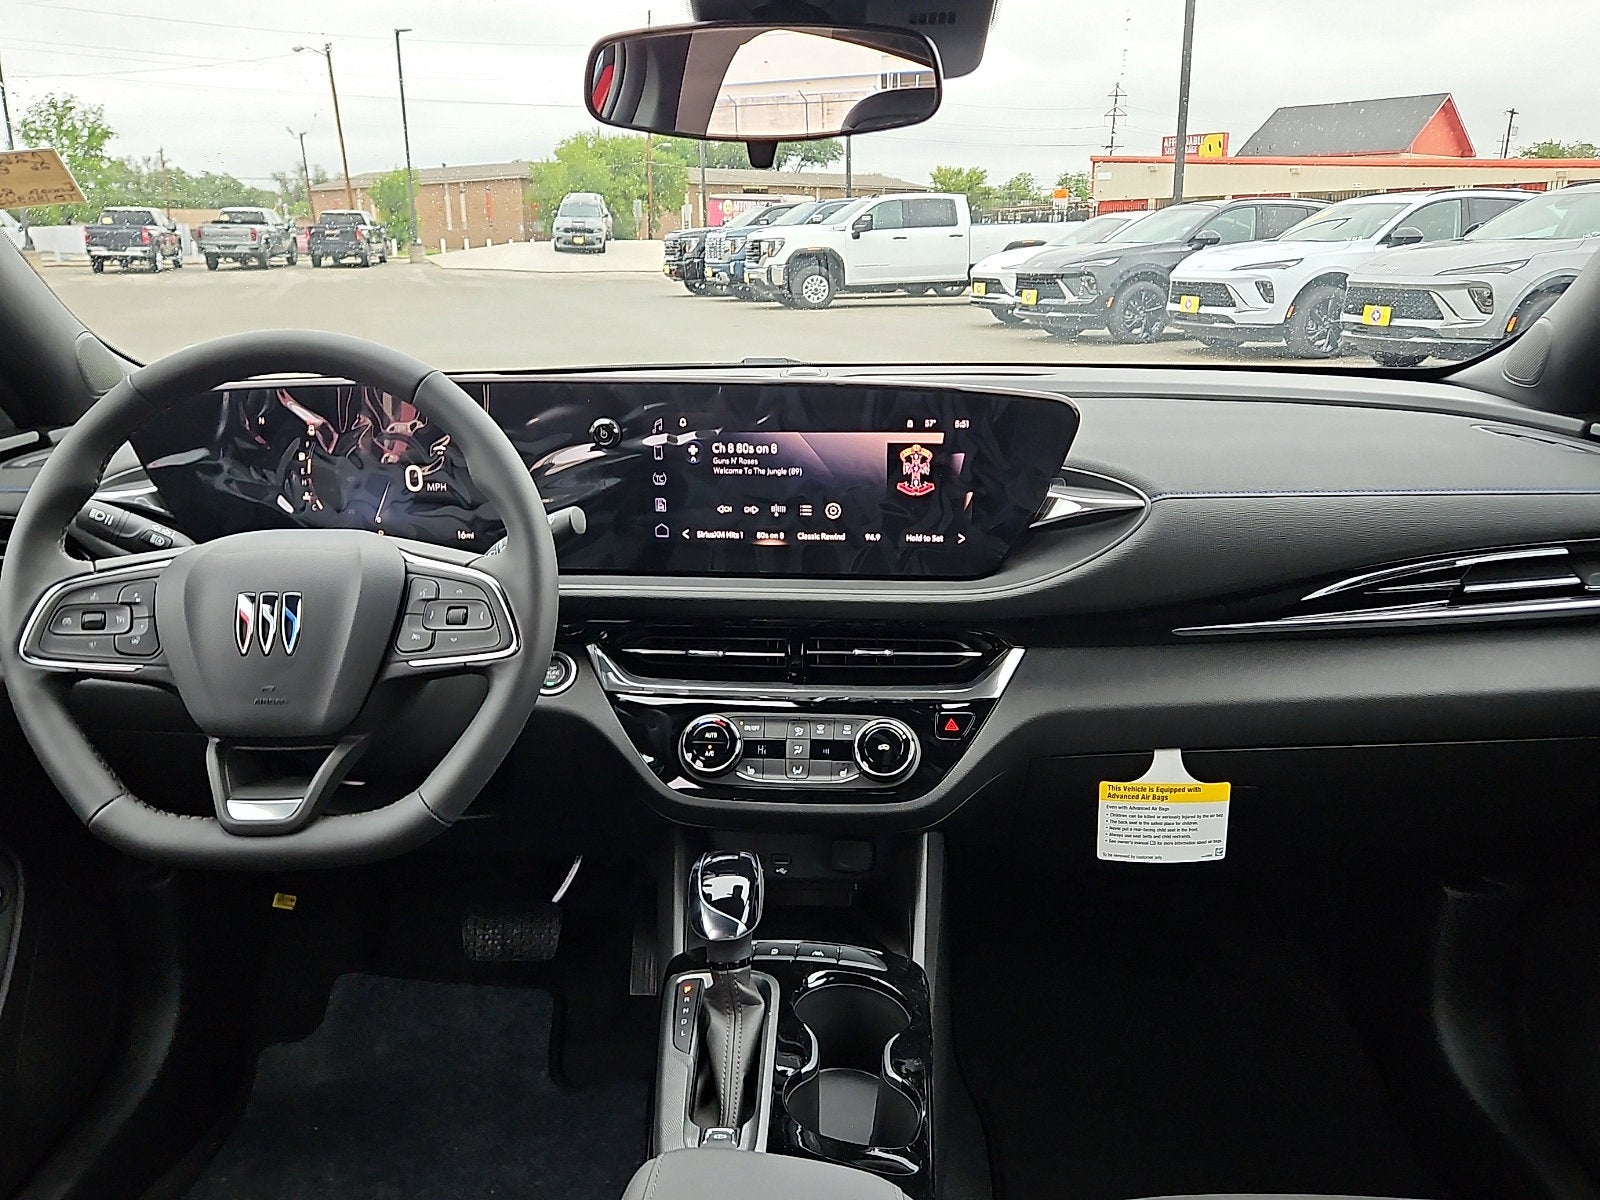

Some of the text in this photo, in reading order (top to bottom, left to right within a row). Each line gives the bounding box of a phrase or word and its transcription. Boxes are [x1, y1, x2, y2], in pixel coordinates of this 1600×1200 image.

[712, 443, 778, 454] Ch 8 80s on 8
[713, 457, 730, 465] Guns
[738, 457, 758, 465] Roses
[713, 467, 743, 475] Welcome
[744, 467, 753, 475] To
[754, 467, 766, 475] The
[767, 467, 788, 477] Jungle
[405, 464, 447, 492] 0 MPH
[906, 533, 923, 542] Hold
[923, 534, 931, 542] to
[1156, 786, 1186, 794] Equipped
[1152, 794, 1169, 802] Bags
[684, 985, 691, 994] P
